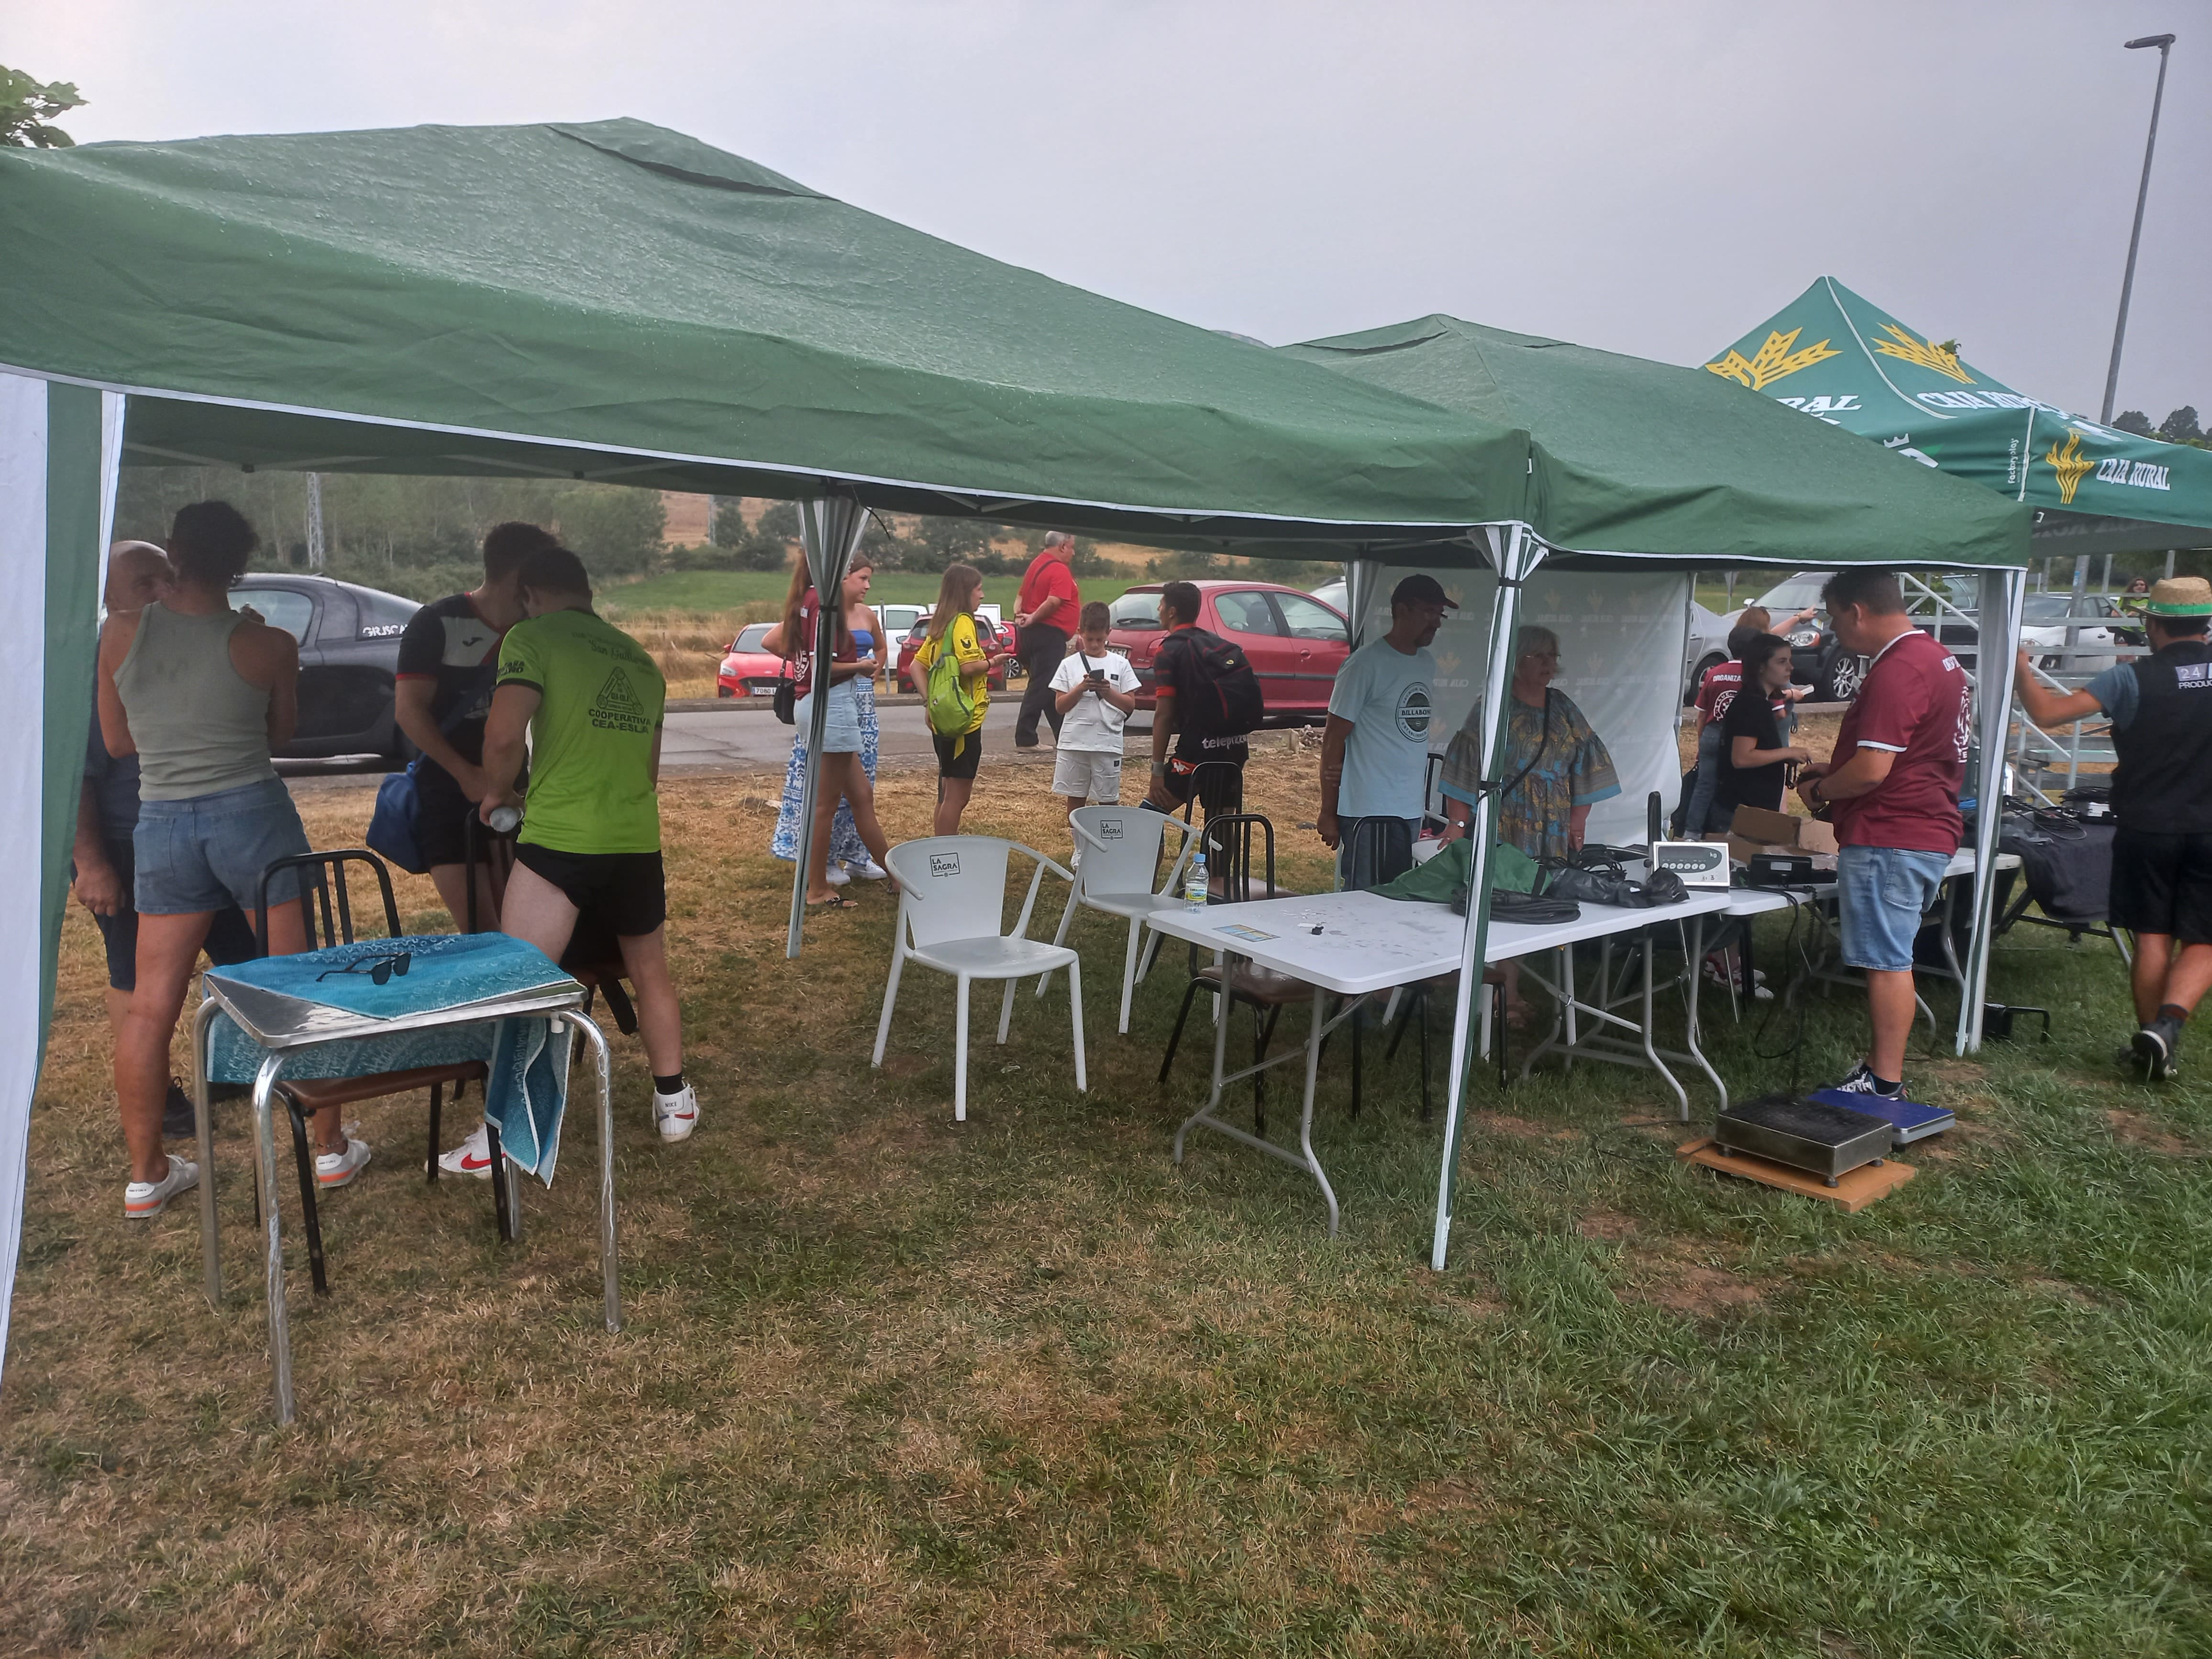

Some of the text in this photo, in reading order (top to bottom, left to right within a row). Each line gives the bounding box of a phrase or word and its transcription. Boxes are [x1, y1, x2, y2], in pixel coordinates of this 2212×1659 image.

[1776, 395, 1862, 412] RAL
[1917, 390, 1998, 410] CAJA
[2096, 458, 2170, 491] CAJA RURAL
[1713, 674, 1742, 682] ORGANIZA
[588, 708, 651, 725] COOPERATIVA
[592, 719, 649, 734] CEA-ESLA
[933, 863, 958, 871] SAGRA
